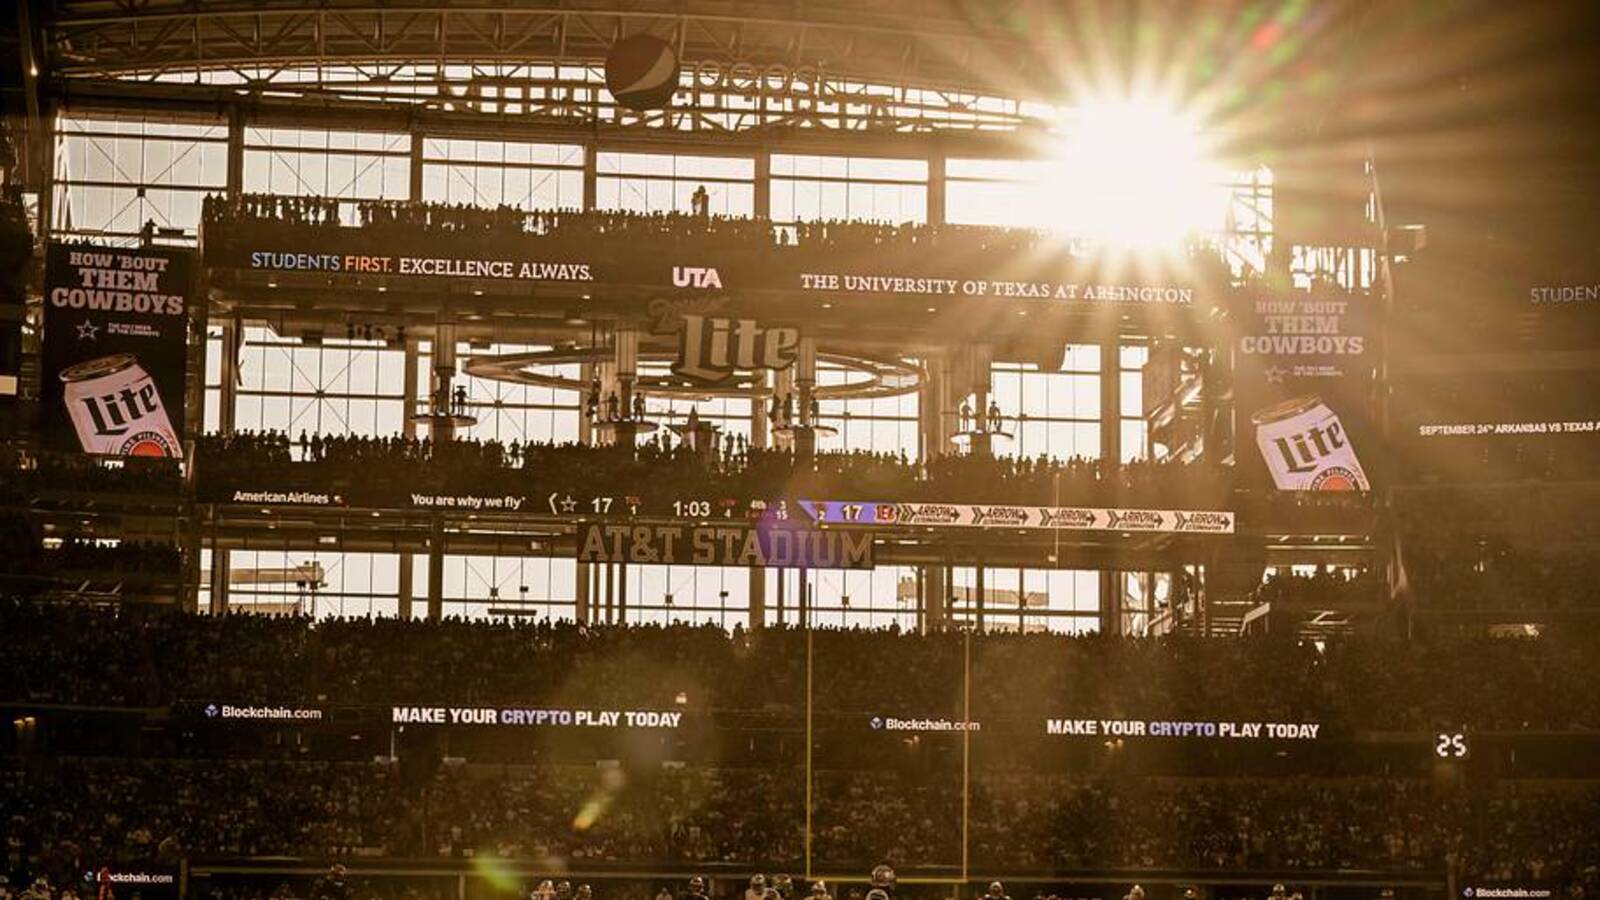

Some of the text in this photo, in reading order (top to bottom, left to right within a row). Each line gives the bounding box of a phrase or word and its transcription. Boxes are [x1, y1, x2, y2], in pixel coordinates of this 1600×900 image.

[69, 252, 169, 272] HOW 'BOUT
[251, 252, 594, 282] STUDENTS FIRST. EXCELLENCE ALWAYS.
[78, 268, 159, 292] THEM
[672, 266, 722, 289] UTA
[801, 274, 1193, 304] THE UNIVERSITY OF TEXAS AT ARLINGTON
[1530, 285, 1600, 303] STUDEN
[51, 287, 183, 316] COWBOYS
[1255, 301, 1348, 315] HOW 'BOUT
[1265, 315, 1340, 334] THEM
[673, 314, 798, 382] Lite
[1241, 336, 1364, 355] COWBOYS
[81, 383, 158, 436] Lite
[1419, 425, 1476, 436] SEPTEMBER
[1495, 423, 1547, 434] ARKANSAS
[1549, 423, 1562, 432] VS
[1563, 422, 1594, 432] TEXAS
[1272, 421, 1345, 473] Lite
[233, 490, 329, 504] American Airlines
[411, 494, 434, 505] You
[435, 496, 455, 506] are
[457, 496, 482, 509] why
[484, 497, 503, 507] we
[592, 498, 613, 513] 17
[631, 505, 637, 515] 1
[673, 501, 711, 516] 1:03
[724, 508, 731, 518] 4
[842, 504, 863, 520] 17
[917, 504, 951, 518] ARROW
[985, 507, 1020, 520] ARROW
[818, 511, 825, 520] 2
[1053, 508, 1088, 521] ARROW
[1122, 510, 1155, 523] ARROW
[1190, 512, 1222, 525] ARROW
[580, 525, 874, 566] AT&T STADIUM
[222, 704, 322, 720] Blockchain.com
[392, 707, 682, 728] MAKE YOUR CRYPTO PLAY TODAY
[1046, 718, 1321, 740] MAKE YOUR CRYPTO PLAY TODAY
[1436, 733, 1468, 758] 25
[97, 871, 173, 884] ockchain.com
[1476, 887, 1551, 898] Blockchain.com
